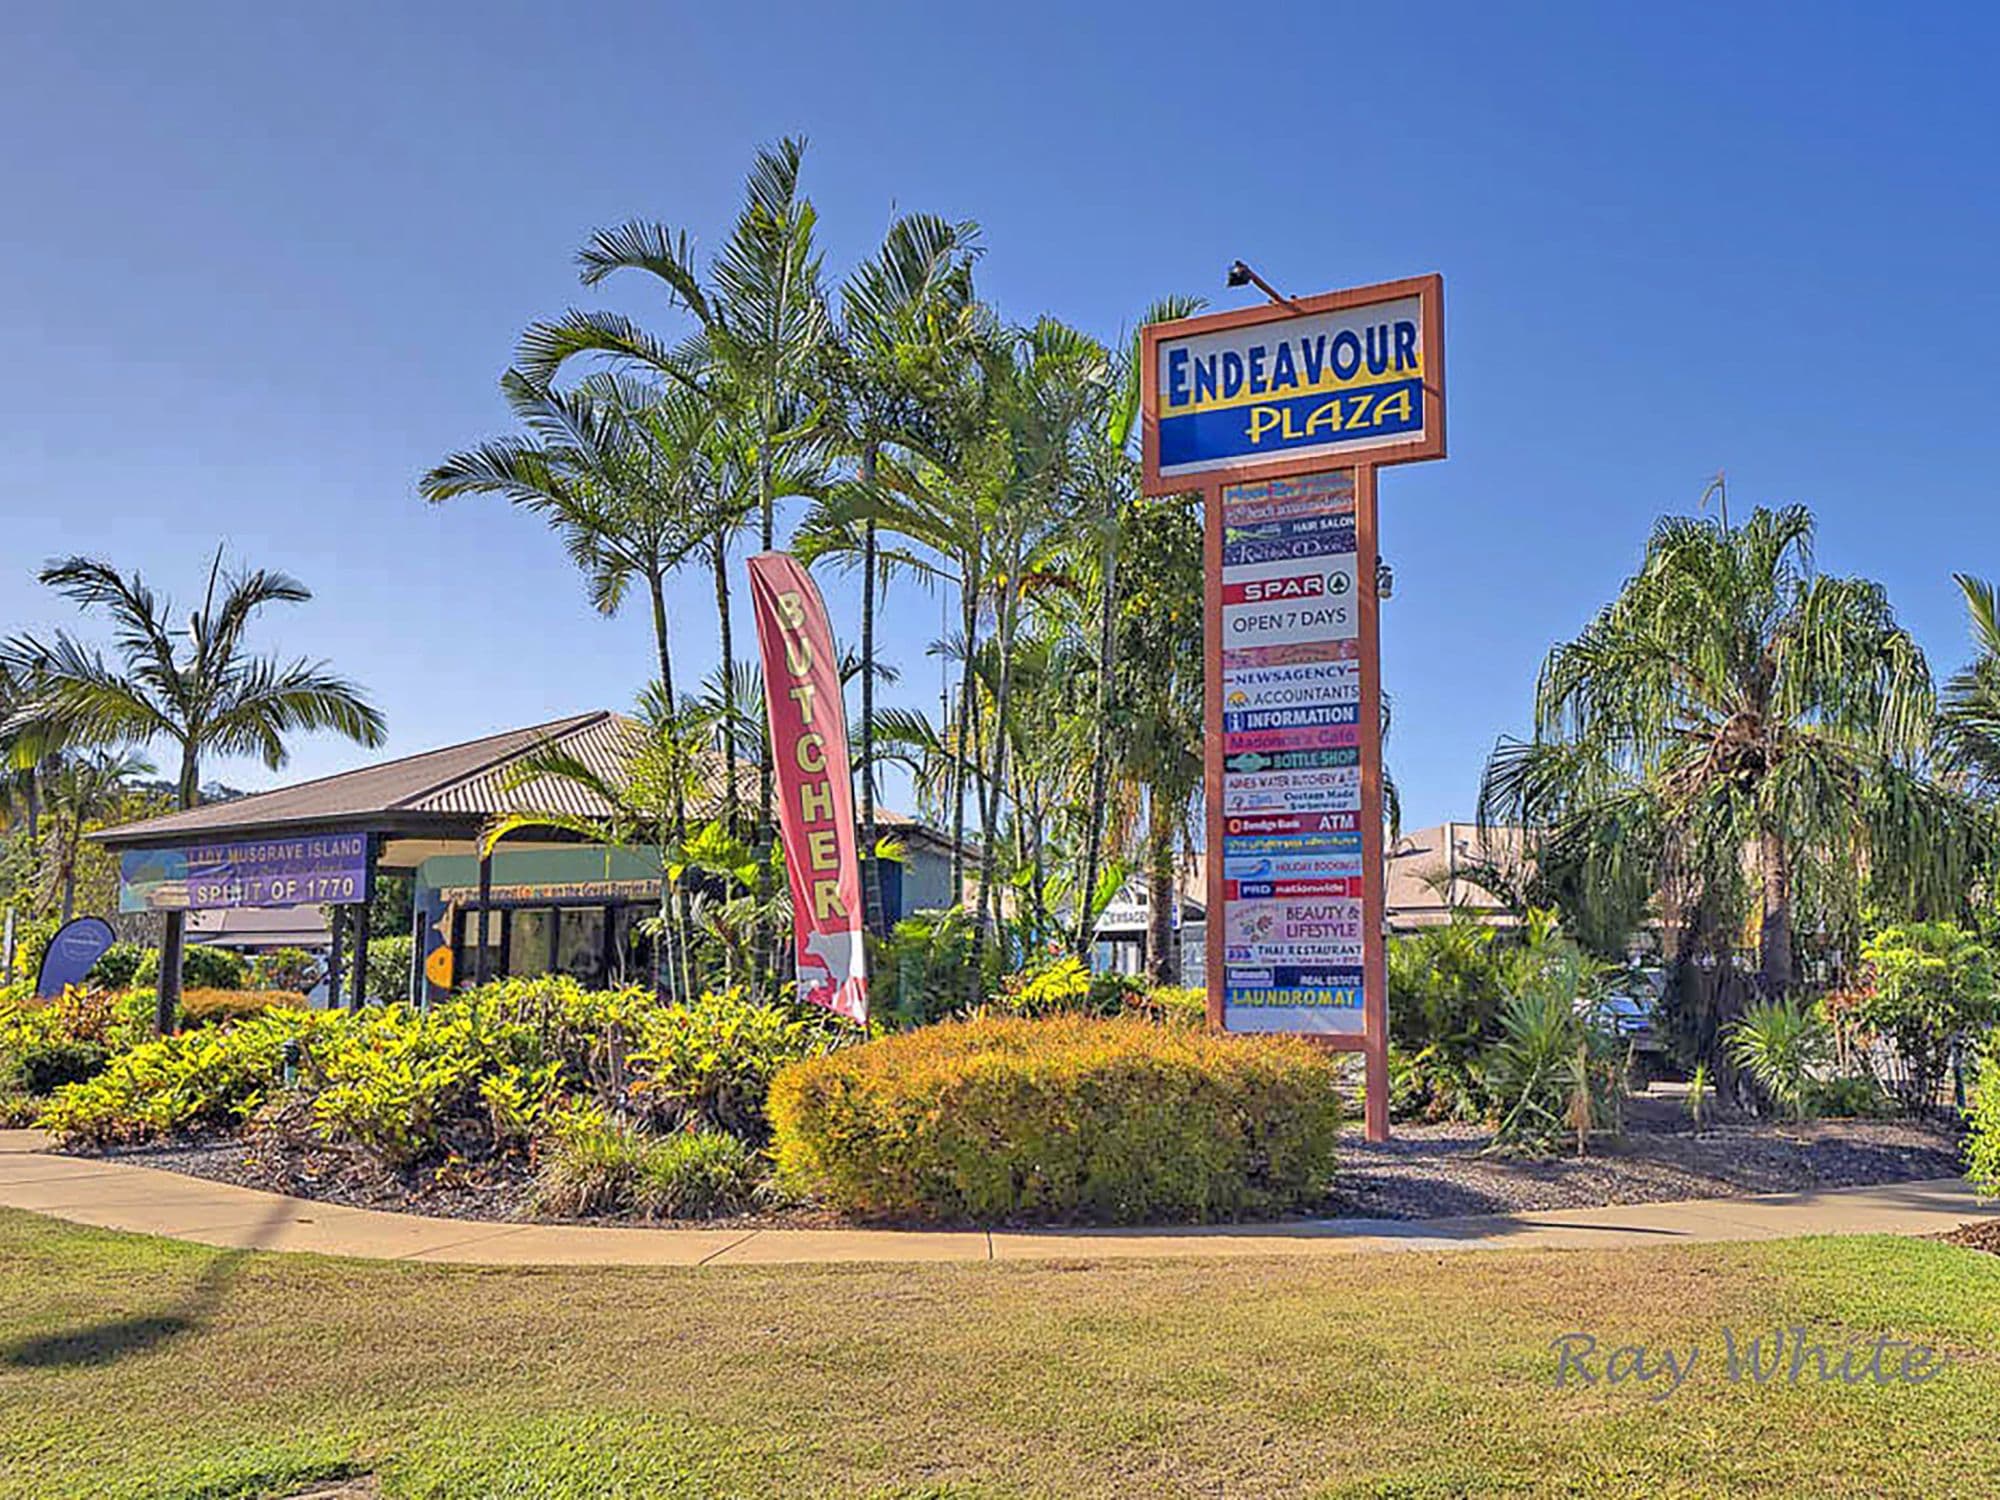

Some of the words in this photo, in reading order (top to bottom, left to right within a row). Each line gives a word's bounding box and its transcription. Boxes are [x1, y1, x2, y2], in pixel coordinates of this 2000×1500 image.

[1169, 321, 1418, 407] ENDEAVOUR
[1245, 389, 1412, 444] PLAZA
[1293, 520, 1319, 533] HAIR
[1320, 516, 1355, 530] SALON
[1244, 577, 1323, 601] SPAR
[1233, 614, 1282, 633] OPEN
[1287, 612, 1297, 628] 7
[1301, 607, 1347, 627] DAYS
[1235, 665, 1348, 686] NEWSAGENCY
[1254, 685, 1360, 705] ACCOUNTANTS
[1247, 706, 1354, 729] INFORMATION
[777, 590, 847, 921] BUTCHER
[1273, 752, 1320, 769] BOTTLE
[1320, 749, 1357, 766] SHOP
[1319, 814, 1355, 831] ATM
[228, 844, 304, 864] MUSGRAVE
[308, 838, 362, 859] ISLAND
[197, 881, 262, 904] SPIIT
[271, 880, 298, 900] OF
[307, 877, 354, 900] 1770
[1242, 884, 1272, 895] PRD
[1275, 883, 1345, 894] nationwide
[1285, 905, 1344, 921] BEAUTY
[1346, 905, 1360, 920] &
[1286, 922, 1358, 938] LIFESTYLE
[1258, 945, 1284, 956] THAI
[1288, 944, 1361, 956] RESTAURANT
[1232, 989, 1355, 1007] LAUNDROMAT
